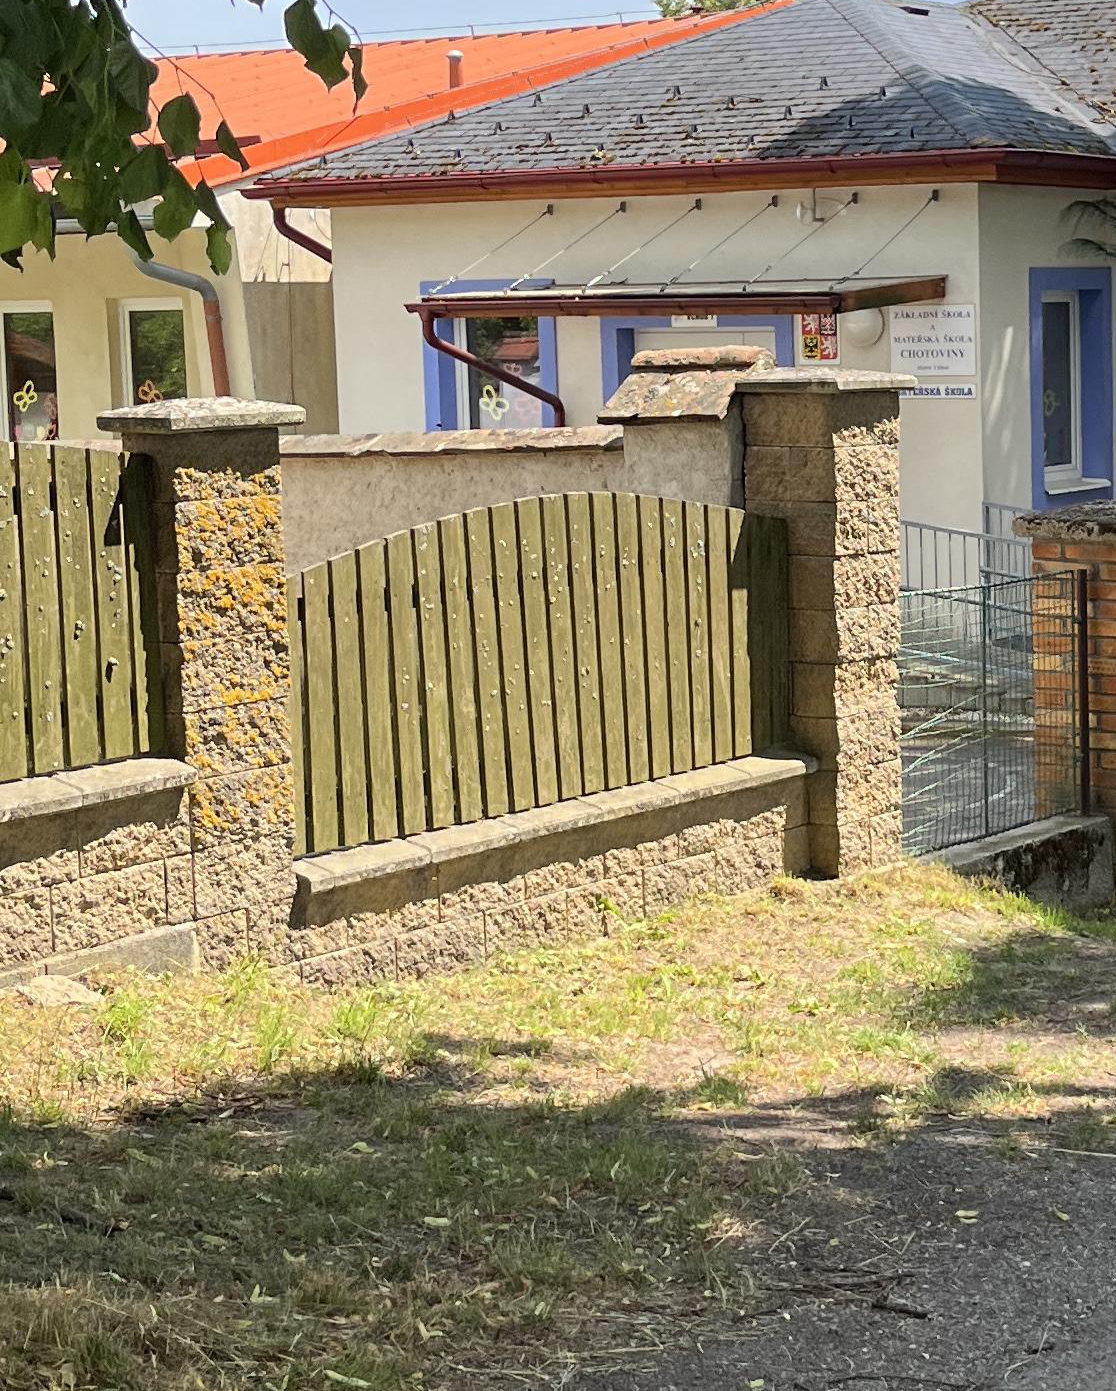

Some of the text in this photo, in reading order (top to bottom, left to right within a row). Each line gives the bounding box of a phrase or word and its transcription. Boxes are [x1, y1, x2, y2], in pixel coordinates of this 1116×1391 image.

[941, 310, 971, 319] ŠKOLA
[943, 334, 972, 343] ŠKOLA
[901, 349, 964, 358] CHOTOVINY
[944, 386, 972, 396] ŠKOLA
